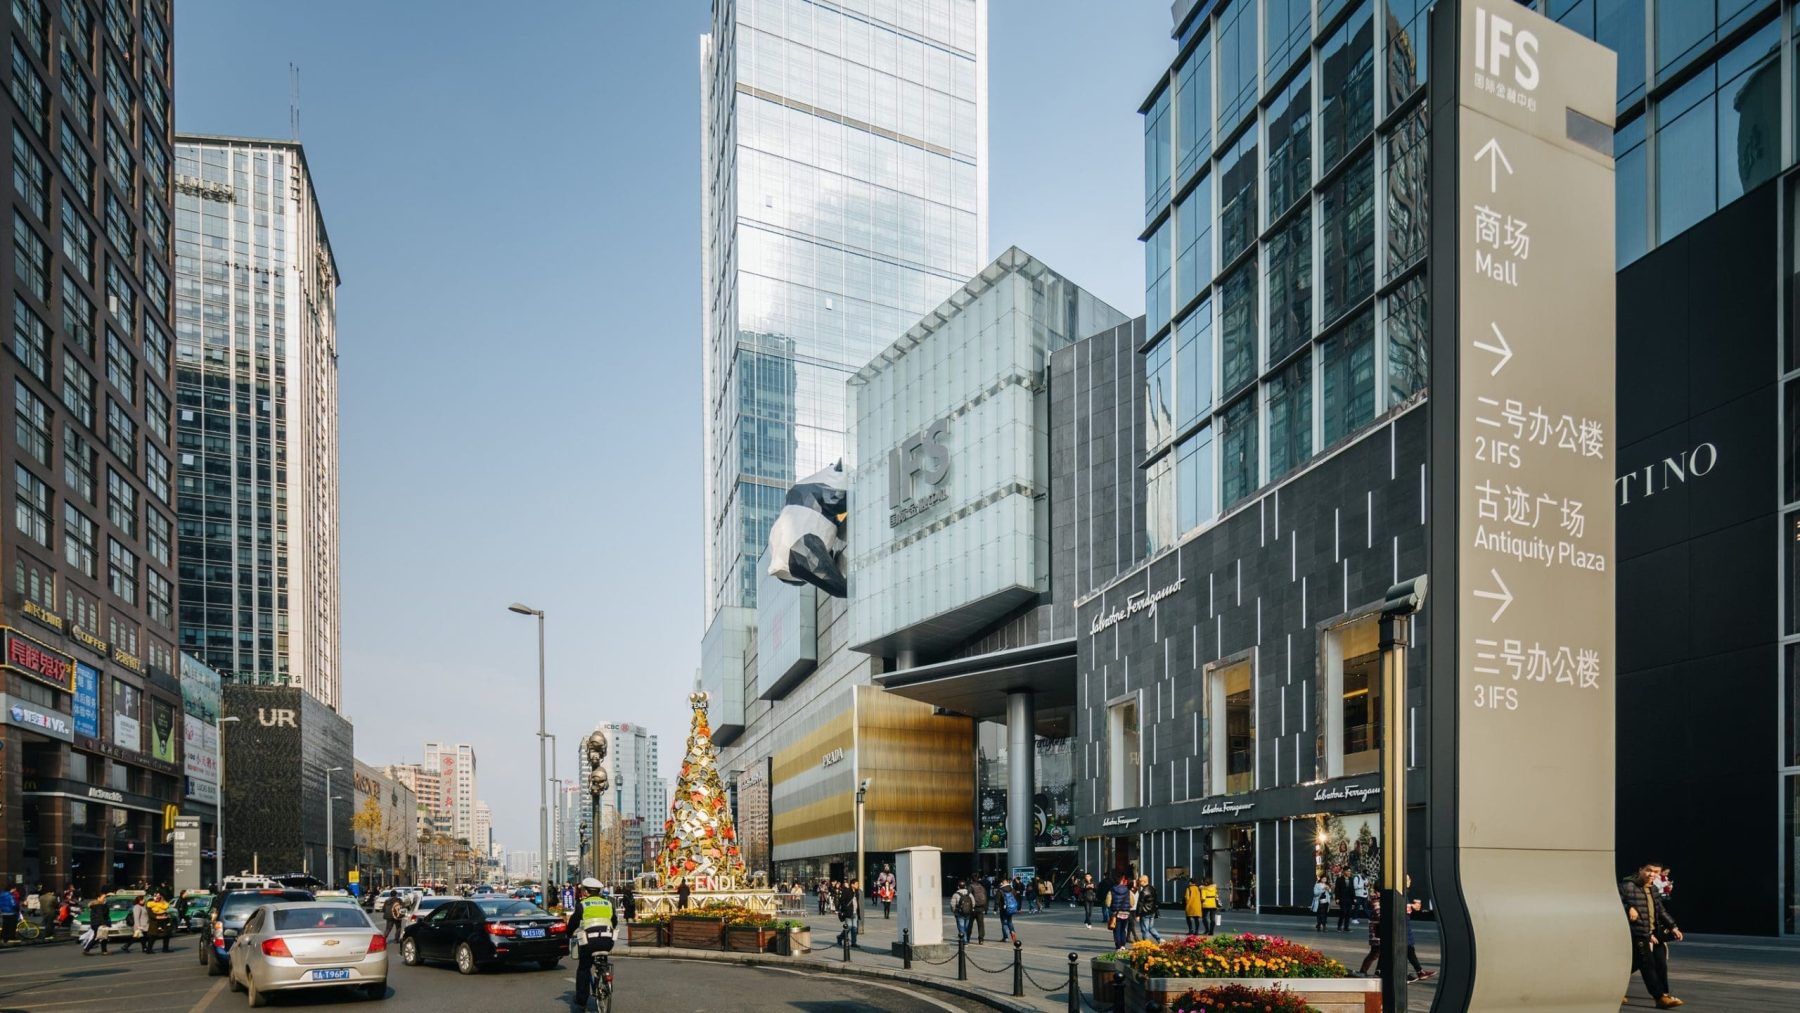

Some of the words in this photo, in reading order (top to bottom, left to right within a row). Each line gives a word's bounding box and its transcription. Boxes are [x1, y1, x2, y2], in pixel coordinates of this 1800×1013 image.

[1475, 7, 1540, 91] IFS
[1474, 204, 1530, 260] 商场
[1475, 249, 1518, 287] Mall
[1475, 396, 1604, 460] 二号办公楼
[1475, 436, 1486, 461] 2
[1491, 441, 1521, 469] IFS
[888, 418, 950, 510] IFS
[1615, 442, 1717, 507] TINO
[1475, 479, 1586, 538] 古迹广场
[1474, 525, 1555, 567] Antiquity
[1558, 541, 1605, 572] Plaza
[1474, 638, 1601, 689] 三号办公楼
[258, 707, 298, 728] UR
[1474, 684, 1486, 708] 3
[1489, 686, 1519, 711] IFS
[822, 747, 844, 768] PRADA
[1344, 784, 1381, 803] Ferragam
